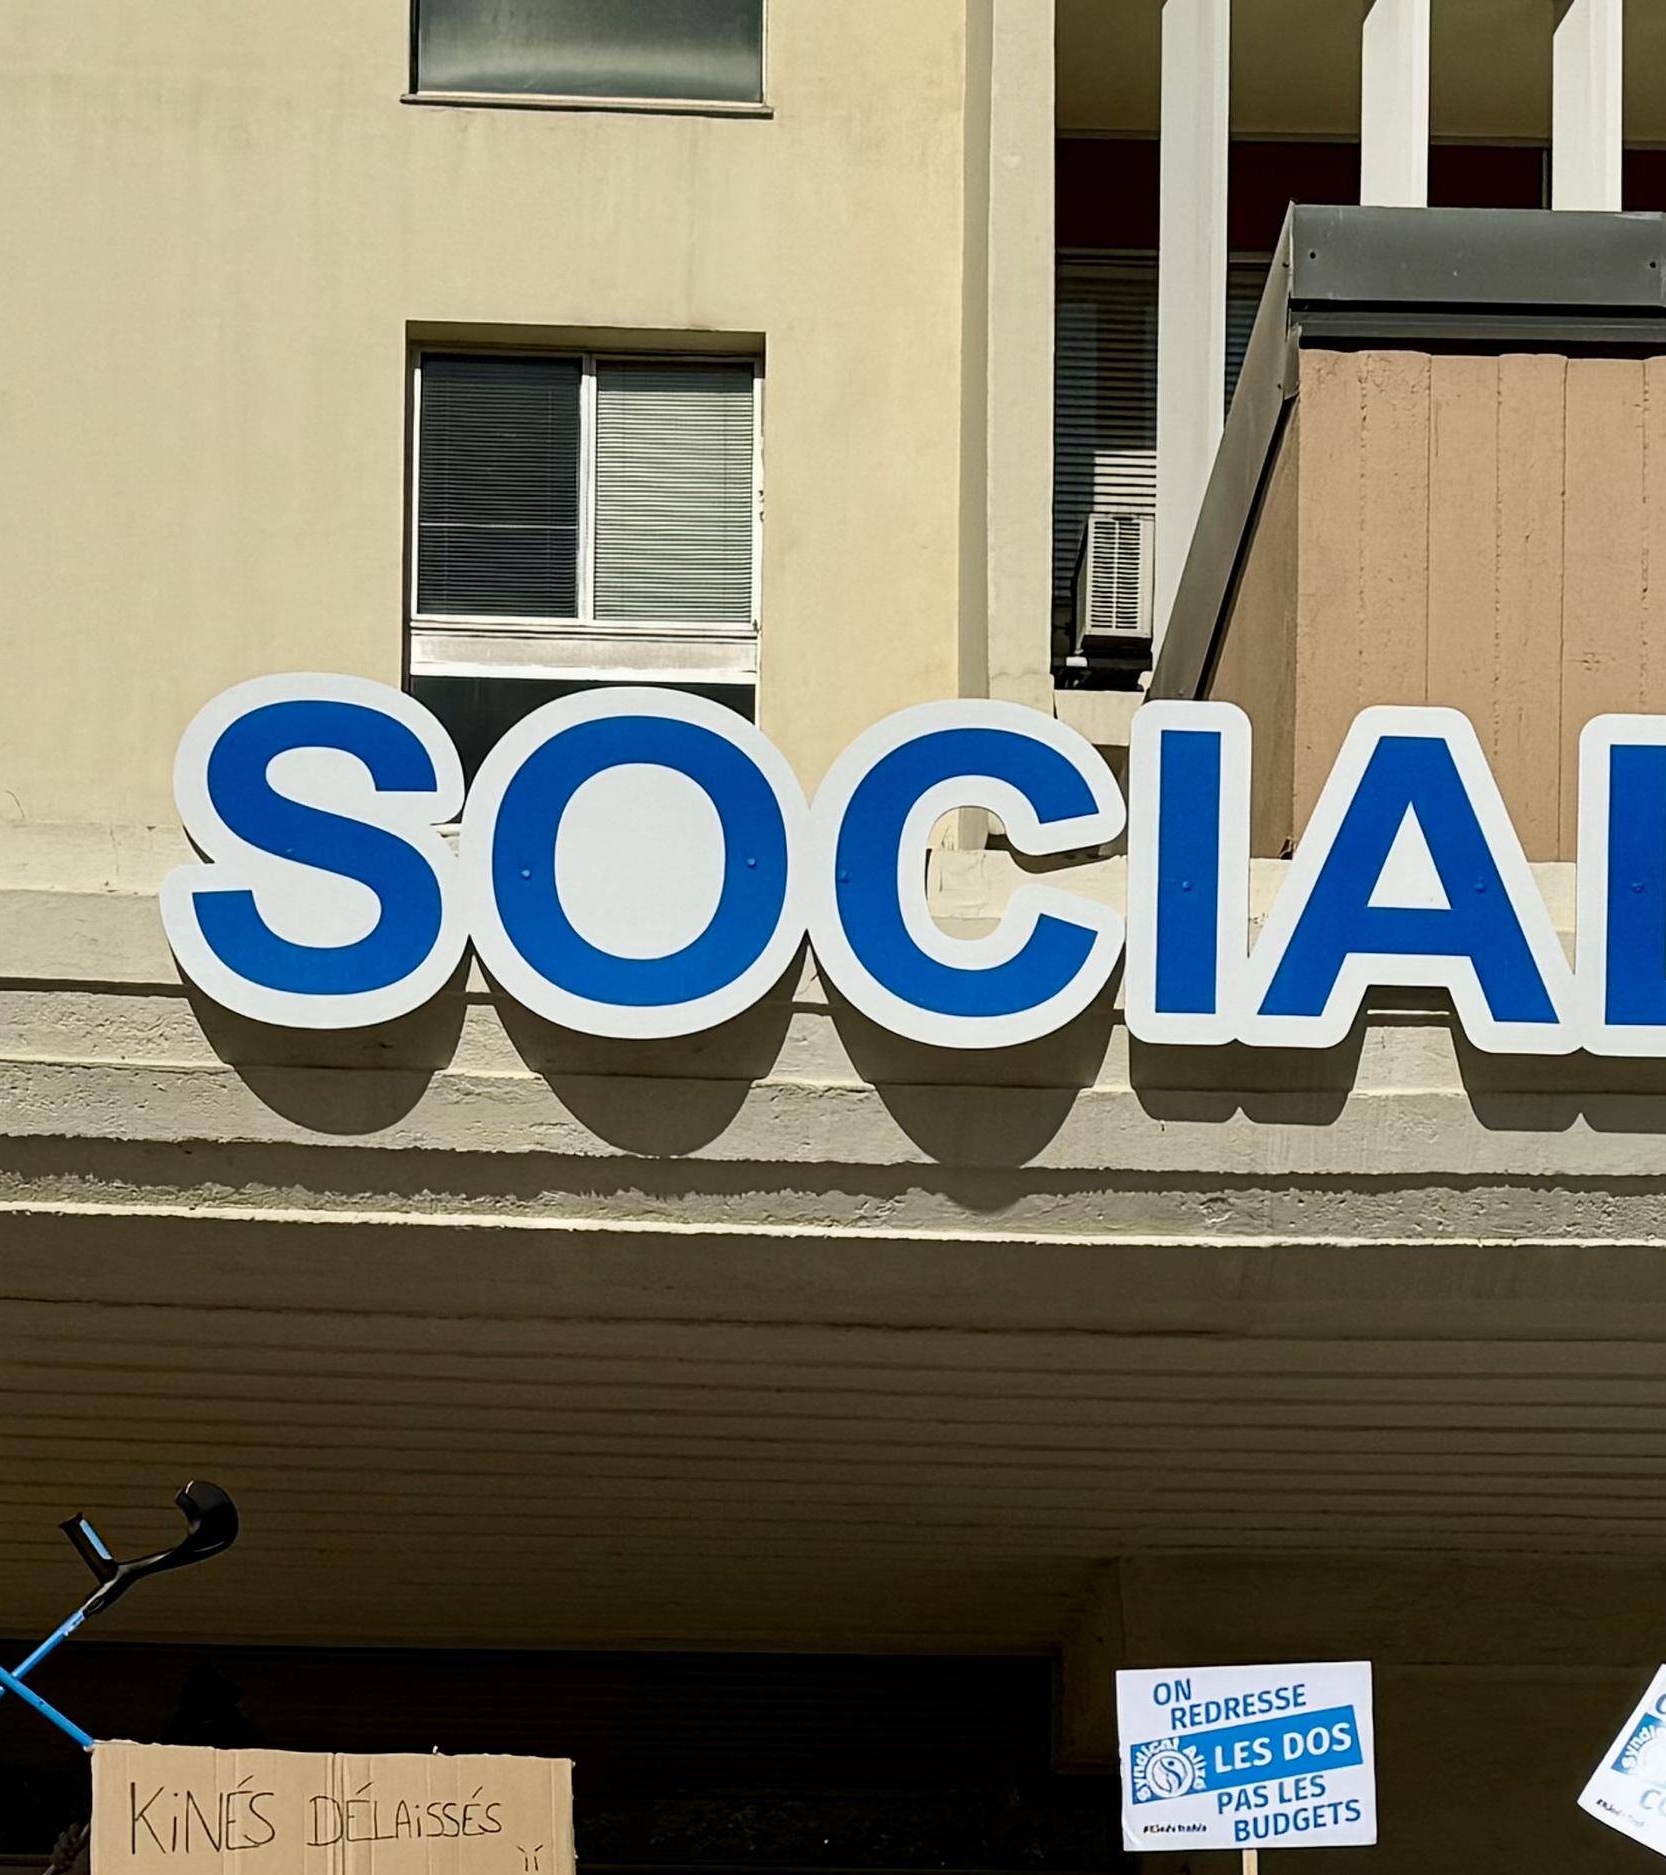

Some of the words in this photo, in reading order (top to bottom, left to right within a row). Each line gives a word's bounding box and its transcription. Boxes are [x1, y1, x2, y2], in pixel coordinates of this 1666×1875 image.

[1152, 1677, 1192, 1705] ON
[1170, 1683, 1307, 1730] REDRESSE
[1213, 1736, 1273, 1774] LES
[1282, 1721, 1352, 1761] DOS
[1217, 1784, 1269, 1815] PAS
[1277, 1773, 1326, 1806] LES
[1233, 1798, 1362, 1843] BUDGETS
